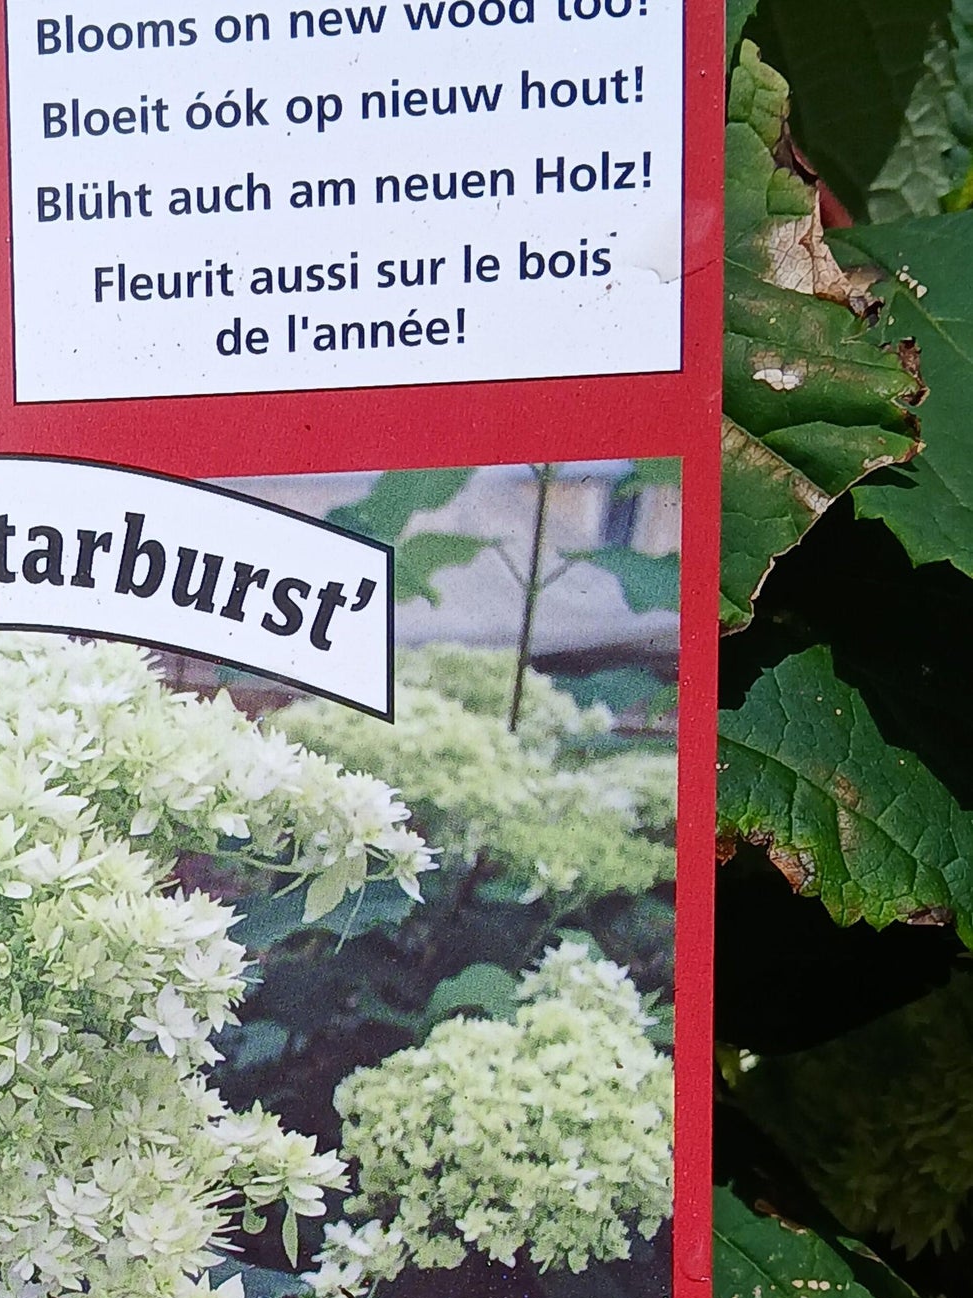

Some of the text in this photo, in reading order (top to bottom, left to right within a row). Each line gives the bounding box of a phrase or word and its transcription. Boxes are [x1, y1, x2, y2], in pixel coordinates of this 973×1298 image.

[36, 10, 199, 56] Blooms
[214, 10, 271, 45] on
[289, 2, 385, 39] new
[404, 0, 536, 31] wood
[42, 65, 646, 139] Bloeit óók op nieuw hout!
[36, 150, 654, 223] Blüht auch am neuen Holz!
[93, 237, 613, 303] Fleurit aussi sur le bois
[216, 306, 467, 357] de l'année!
